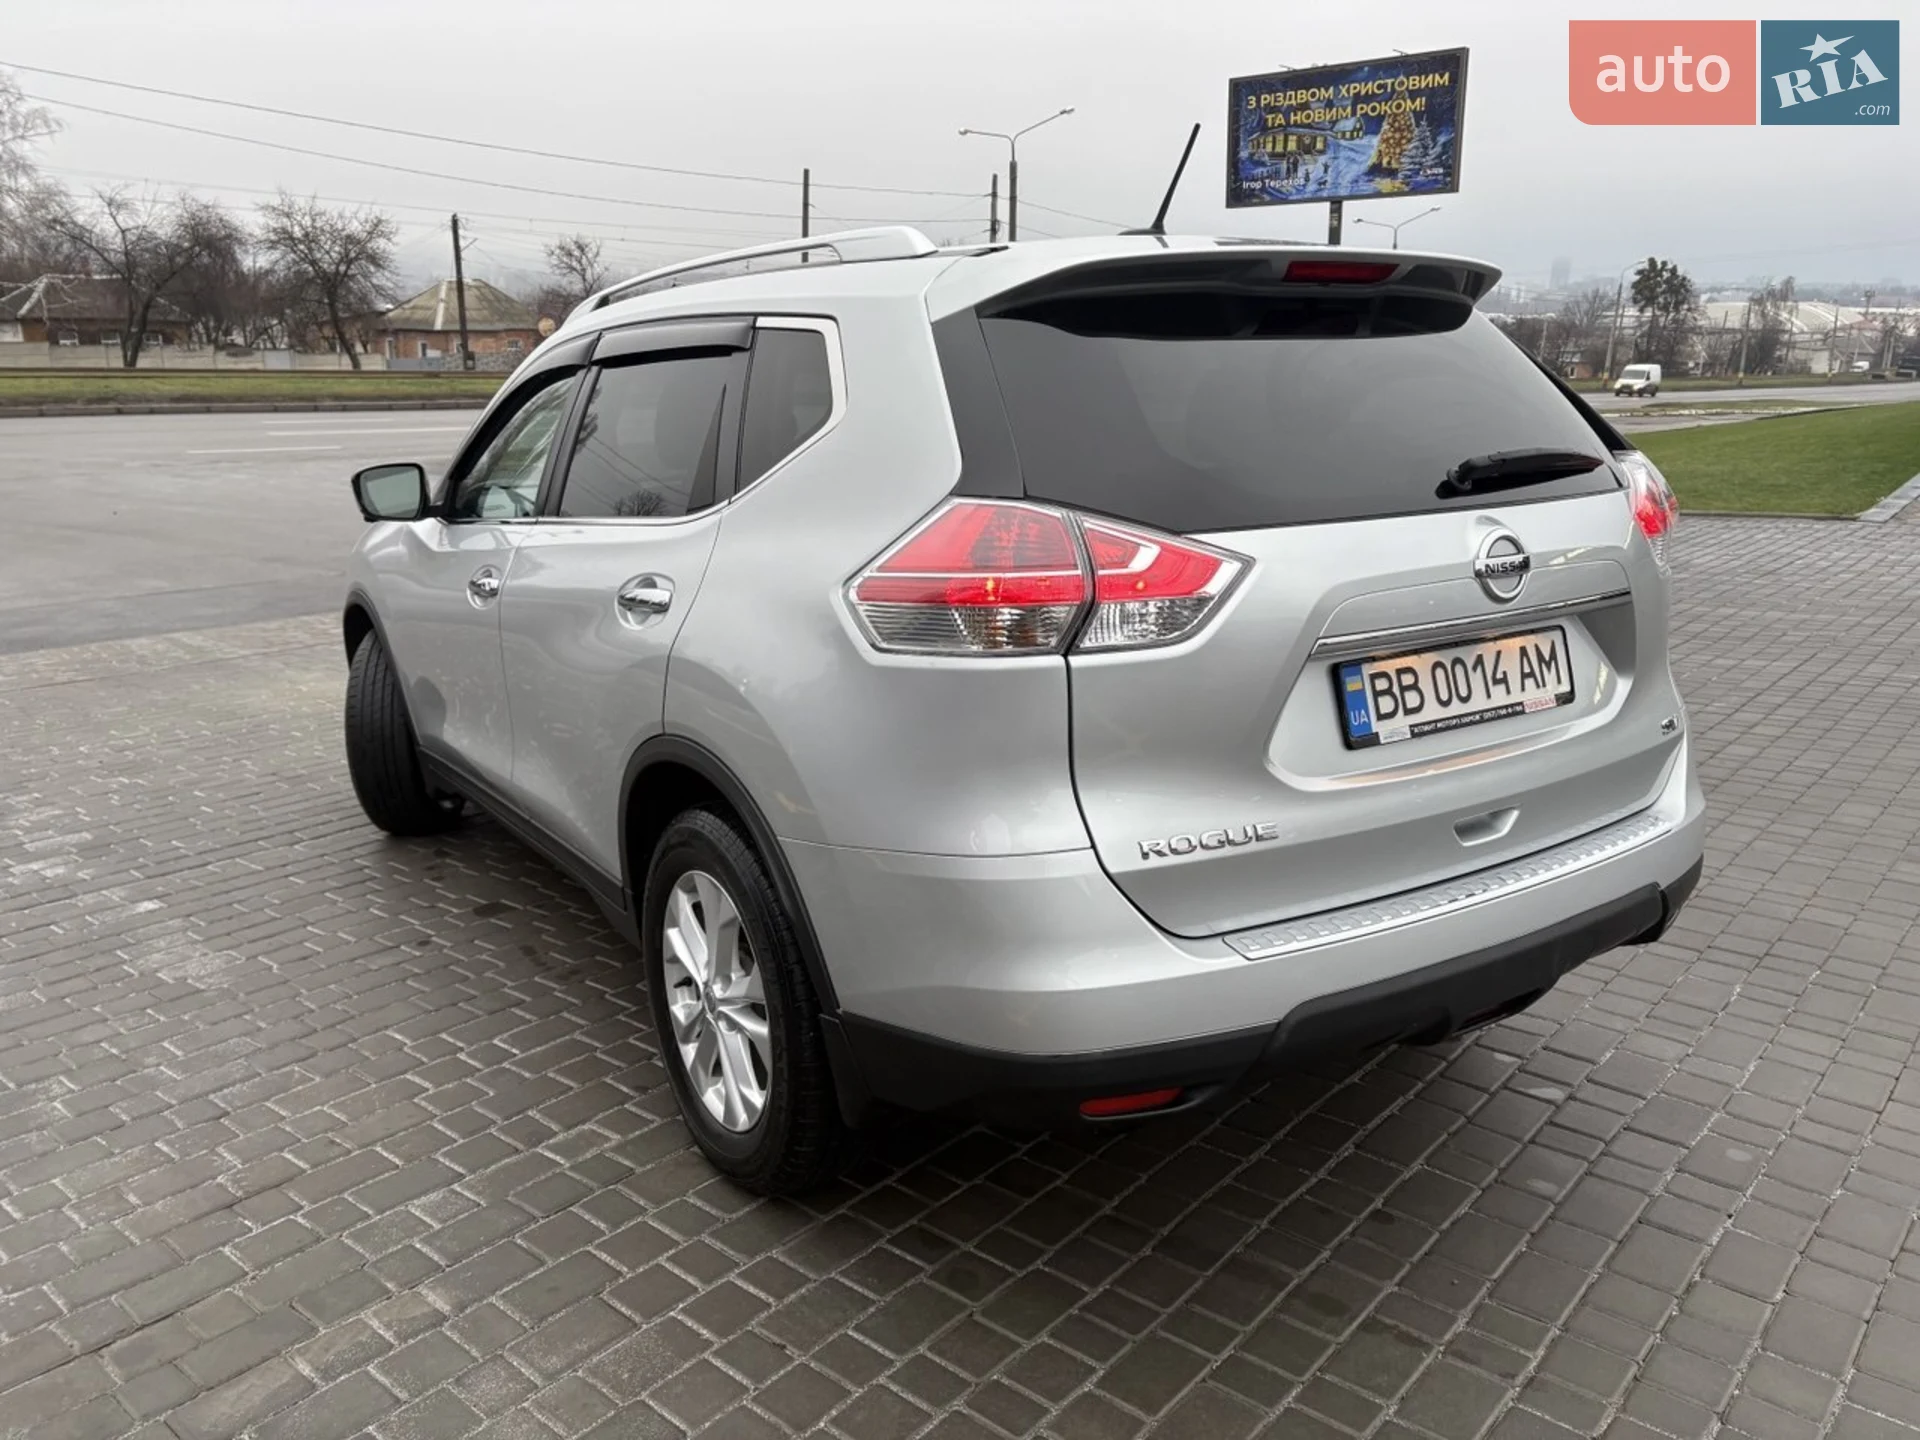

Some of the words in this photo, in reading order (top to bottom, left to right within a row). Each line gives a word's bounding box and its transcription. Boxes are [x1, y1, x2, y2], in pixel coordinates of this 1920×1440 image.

[1260, 86, 1333, 108] РІЗДВОМ
[1338, 72, 1450, 98] ХРИСТОВИМ
[1266, 113, 1286, 128] ТА
[1290, 107, 1351, 126] НОВИМ
[1356, 97, 1426, 117] РОКОМ!
[1368, 668, 1425, 721] BB
[1431, 650, 1511, 708] 0014
[1519, 640, 1562, 692] AM
[1350, 711, 1369, 726] UA
[1137, 822, 1279, 860] ROGUE
